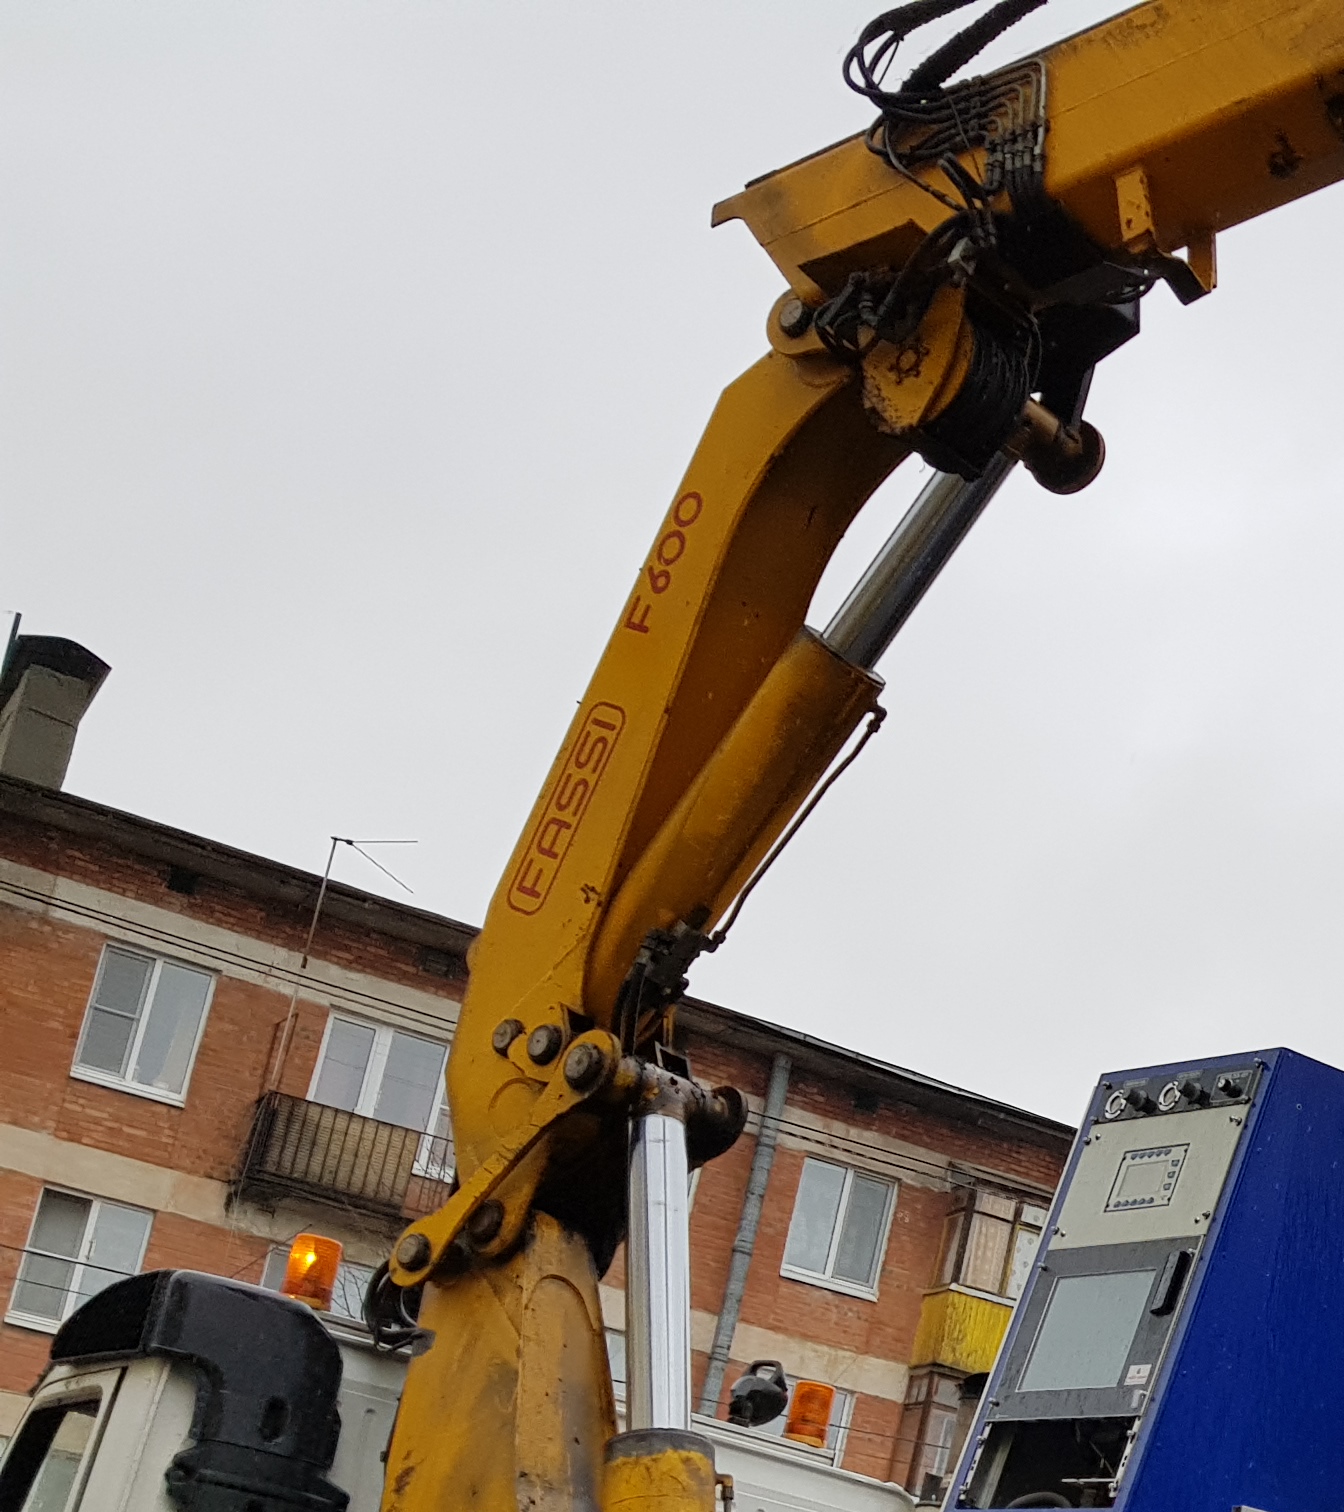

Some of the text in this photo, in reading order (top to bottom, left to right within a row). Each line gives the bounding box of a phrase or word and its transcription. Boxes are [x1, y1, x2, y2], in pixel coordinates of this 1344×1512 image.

[624, 491, 703, 634] F 600
[516, 717, 617, 899] FASSI
